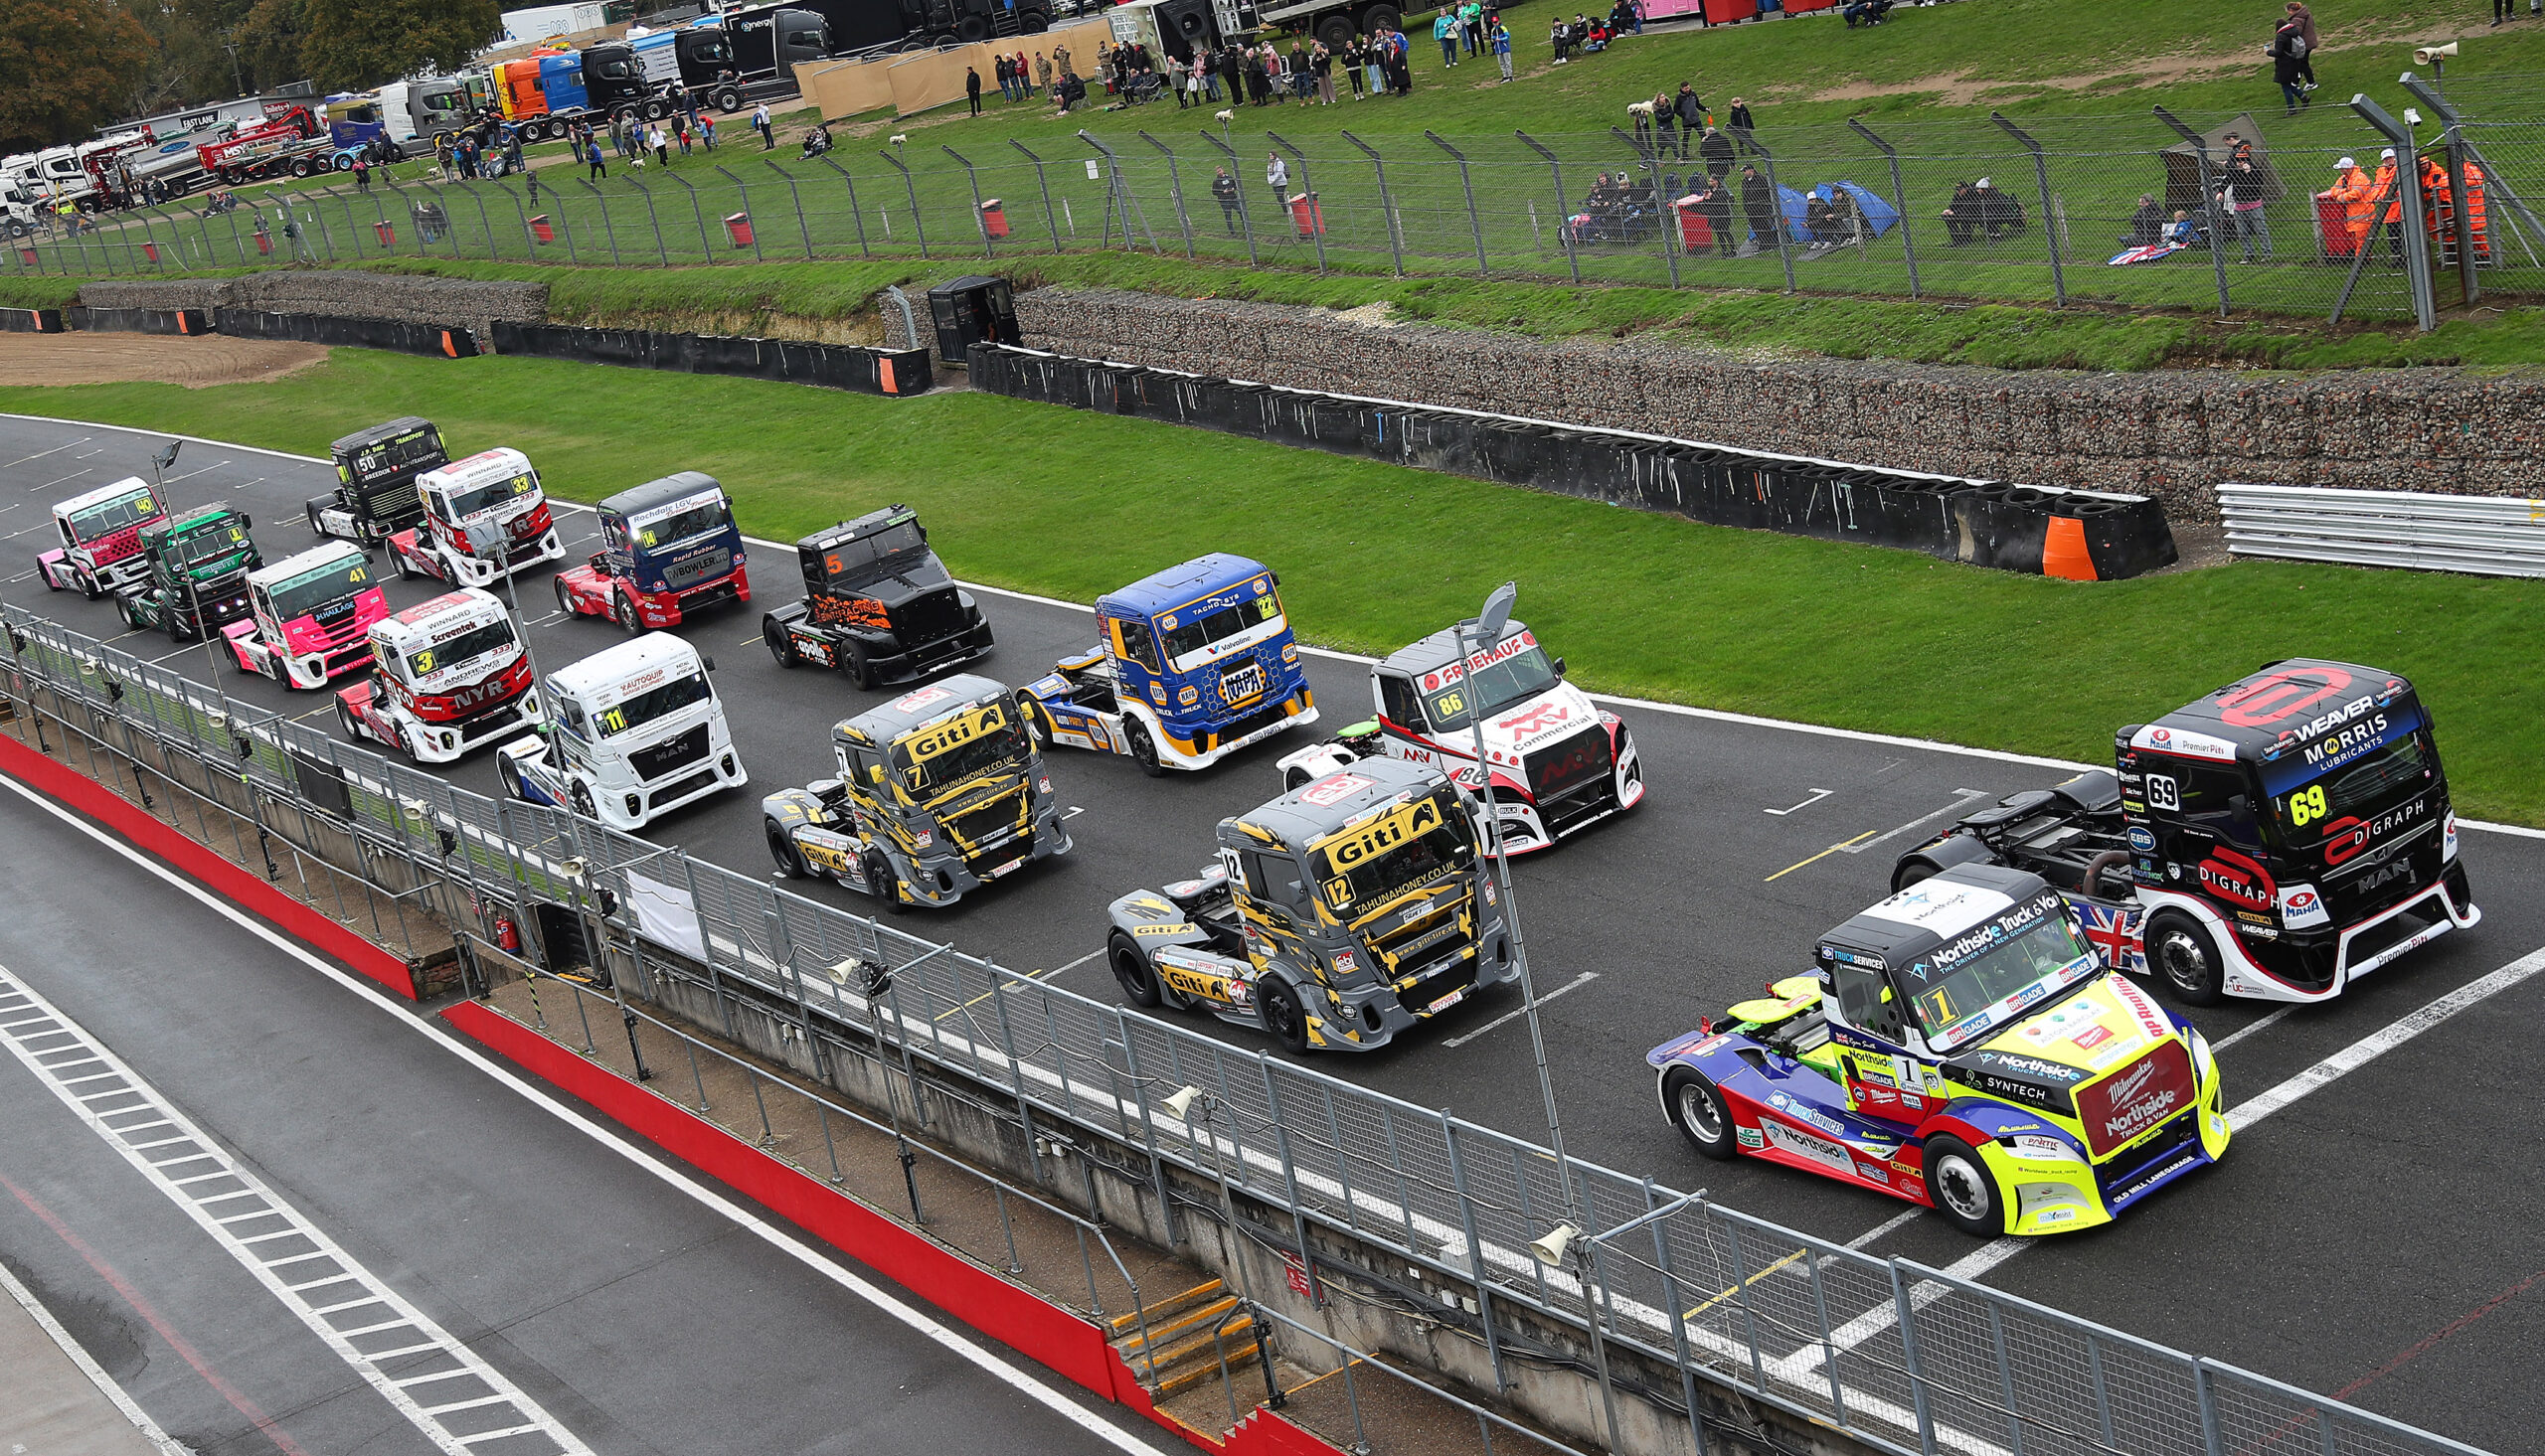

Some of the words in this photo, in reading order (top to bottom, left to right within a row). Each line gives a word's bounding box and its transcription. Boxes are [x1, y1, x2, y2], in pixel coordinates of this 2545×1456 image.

[264, 103, 284, 114] Toilets
[182, 117, 199, 129] FAST
[199, 114, 216, 125] LANE
[395, 429, 425, 445] TRANSPORT
[358, 456, 377, 472] 50
[467, 462, 502, 479] WINNARD
[512, 477, 530, 494] 33
[135, 499, 154, 513] 40
[519, 492, 535, 502] 333
[465, 511, 482, 521] 333
[633, 504, 673, 523] Rochdale
[675, 498, 693, 510] LGV
[642, 532, 657, 548] 14
[672, 551, 693, 564] Rapid
[693, 544, 717, 557] Rubber
[825, 553, 844, 574] 5
[349, 566, 367, 583] 41
[838, 599, 880, 618] RACING
[1258, 596, 1274, 613] 22
[427, 608, 472, 631] WINNARD
[430, 620, 478, 644] Screentek
[491, 644, 511, 657] 333
[797, 639, 827, 659] apollo
[1221, 635, 1252, 652] Valvoline
[417, 651, 434, 673] 3
[443, 659, 501, 686] ANDREWS
[814, 656, 829, 667] TYRES
[424, 669, 445, 683] 333
[626, 669, 664, 690] AUTOQUIP
[1225, 668, 1262, 702] NAPA
[453, 679, 505, 710] NYR
[1180, 688, 1197, 702] NAPA
[1438, 693, 1463, 716] 86
[605, 709, 625, 731] 11
[1154, 708, 1174, 718] TRUCK
[1180, 703, 1202, 715] TRUCK
[2293, 695, 2375, 742] WEAVER
[915, 723, 971, 756] Giti
[1248, 731, 1264, 744] AUTO
[1264, 725, 1281, 738] PARTS
[1512, 714, 1593, 752] Commercial
[2149, 737, 2172, 751] MAHA
[2303, 713, 2389, 765] MORRIS
[656, 742, 690, 762] MAN
[2319, 735, 2384, 772] LUBRICANTS
[908, 765, 923, 788] 7
[929, 753, 1016, 797] TAHUNAHONEY.CO.UK
[1457, 766, 1484, 785] 86
[956, 782, 1008, 808] www.giti-tire.eu
[2148, 776, 2177, 807] 69
[1358, 806, 1379, 820] TRUCK
[1378, 798, 1398, 813] PARTS
[2289, 784, 2328, 827] 69
[2353, 799, 2425, 846] DIGRAPH
[1335, 821, 1402, 865] Giti
[2129, 832, 2152, 845] EBS
[804, 847, 830, 865] Giti
[1224, 853, 1243, 882] 12
[2356, 857, 2411, 894] MAN
[1326, 878, 1352, 906] 12
[1354, 859, 1457, 916] TAHUNAHONEY.CO.UK
[2199, 866, 2282, 910] DIGRAPH
[2287, 898, 2320, 918] MAHA
[1136, 925, 1172, 935] Giti
[1397, 923, 1458, 957] www.giti-tire.eu
[1931, 923, 2002, 971] Northside
[1996, 906, 2035, 932] Truck
[2031, 902, 2044, 917] &
[2241, 923, 2280, 937] WEAVER
[1940, 964, 1954, 976] THE
[1953, 951, 1980, 972] DRIVER
[1994, 934, 2010, 948] NEW
[2008, 915, 2045, 939] GENERATION
[1335, 952, 1355, 971] febi
[2059, 960, 2091, 982] BRIGADE
[1169, 971, 1206, 995] Giti
[1430, 992, 1459, 1011] ODYSSEY
[1932, 988, 1956, 1026] 1
[2008, 985, 2045, 1011] BRIGADE
[1949, 1015, 1990, 1043] BRIGADE
[1848, 1050, 1894, 1068] Northside
[1997, 1054, 2083, 1081] Northside
[1862, 1071, 1895, 1087] BRIGADE
[1901, 1058, 1916, 1083] 1
[2006, 1065, 2036, 1075] TRUCK
[2047, 1071, 2064, 1082] VAN
[2108, 1057, 2154, 1105] Milwaukee
[1987, 1076, 2046, 1100] SYNTECH
[1902, 1095, 1920, 1105] nets
[2105, 1089, 2176, 1137] Northside
[2120, 1122, 2146, 1139] TRUCK
[2152, 1108, 2169, 1122] VAN
[1782, 1126, 1850, 1162] Northside
[1892, 1162, 1912, 1174] Giti
[2113, 1191, 2131, 1205] OLD
[2128, 1181, 2148, 1197] MILL
